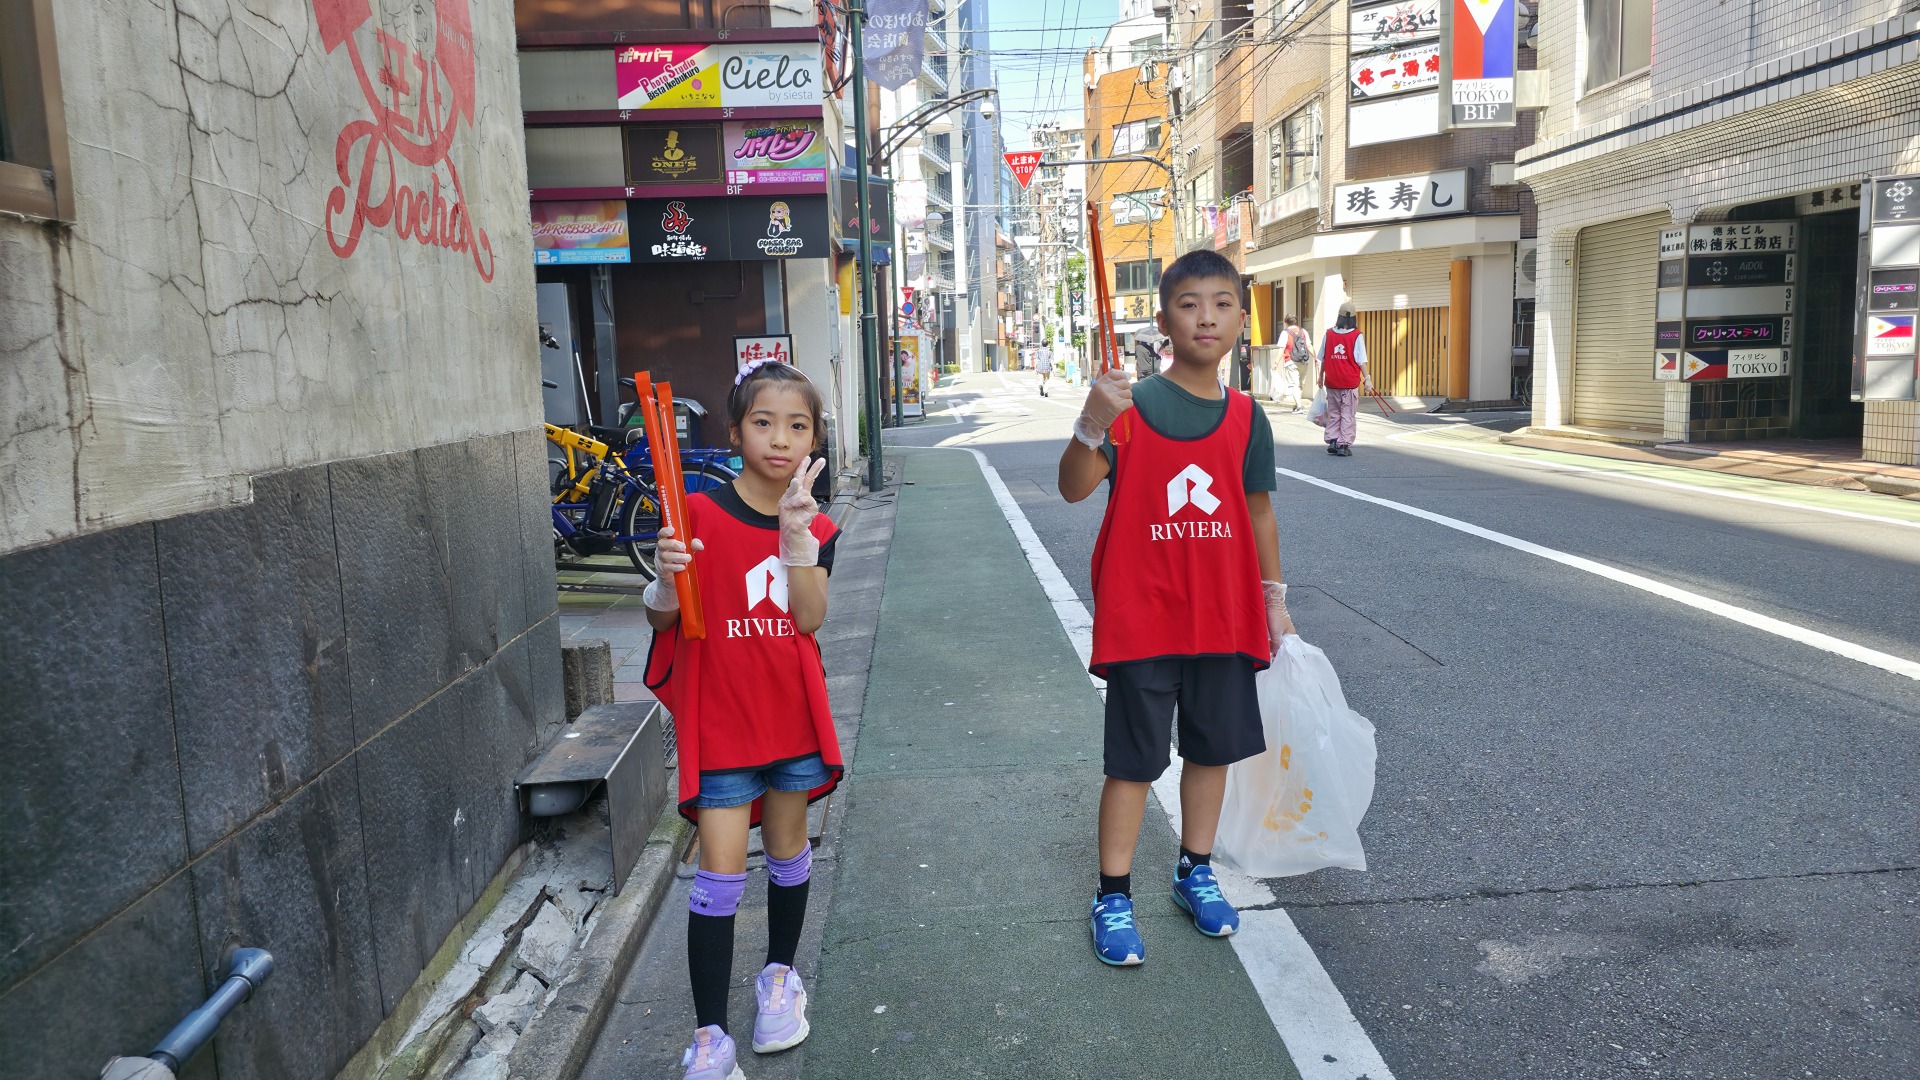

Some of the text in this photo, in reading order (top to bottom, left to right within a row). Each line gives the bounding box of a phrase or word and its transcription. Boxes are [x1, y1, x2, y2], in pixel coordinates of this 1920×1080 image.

[1363, 12, 1378, 22] 2F
[614, 32, 626, 42] 7F
[718, 29, 731, 39] 6F
[618, 47, 674, 63] ポケパラ
[639, 59, 696, 94] Photo Studio
[722, 55, 812, 89] Cielo
[665, 66, 700, 91] Ikebukuro
[1455, 82, 1495, 90] フィリピン
[769, 90, 813, 102] by siesta
[1455, 89, 1509, 103] TOKYO
[620, 110, 632, 120] 4F
[723, 108, 735, 118] 3F
[1463, 104, 1500, 121] B1F
[1011, 155, 1037, 165] 止まれ
[1015, 166, 1034, 174] STOP
[624, 187, 635, 197] 1F
[727, 185, 743, 195] B1F
[1346, 181, 1453, 216] 珠寿し
[1732, 362, 1778, 375] TOKYO
[1149, 521, 1232, 541] RIVIERA
